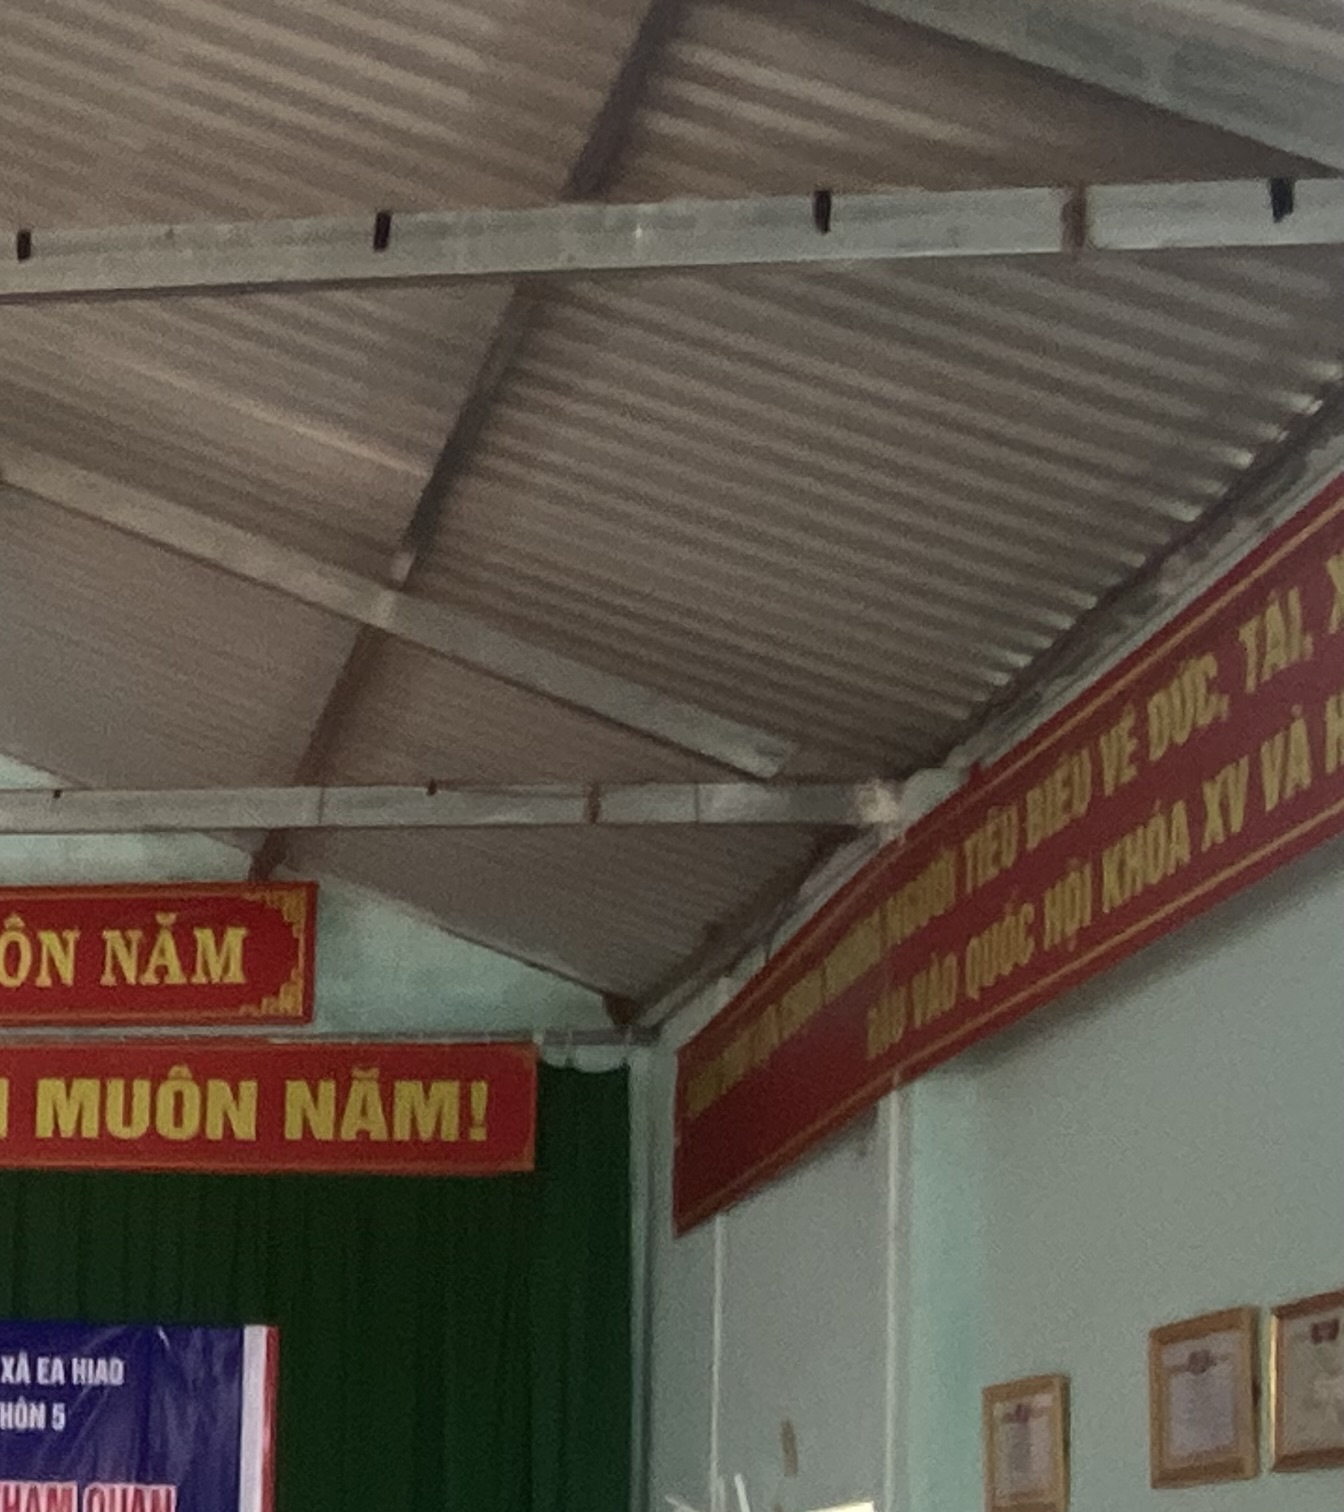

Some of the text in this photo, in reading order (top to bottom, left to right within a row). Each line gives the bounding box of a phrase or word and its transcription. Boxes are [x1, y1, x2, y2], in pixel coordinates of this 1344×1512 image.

[1201, 755, 1250, 852] XV
[1261, 703, 1312, 812] VÀ
[99, 912, 248, 986] NĂM
[35, 1064, 258, 1141] MUÔN
[284, 1067, 489, 1143] NĂM!
[36, 1356, 66, 1385] EA
[71, 1357, 125, 1386] HIAO
[52, 1402, 66, 1431] 5
